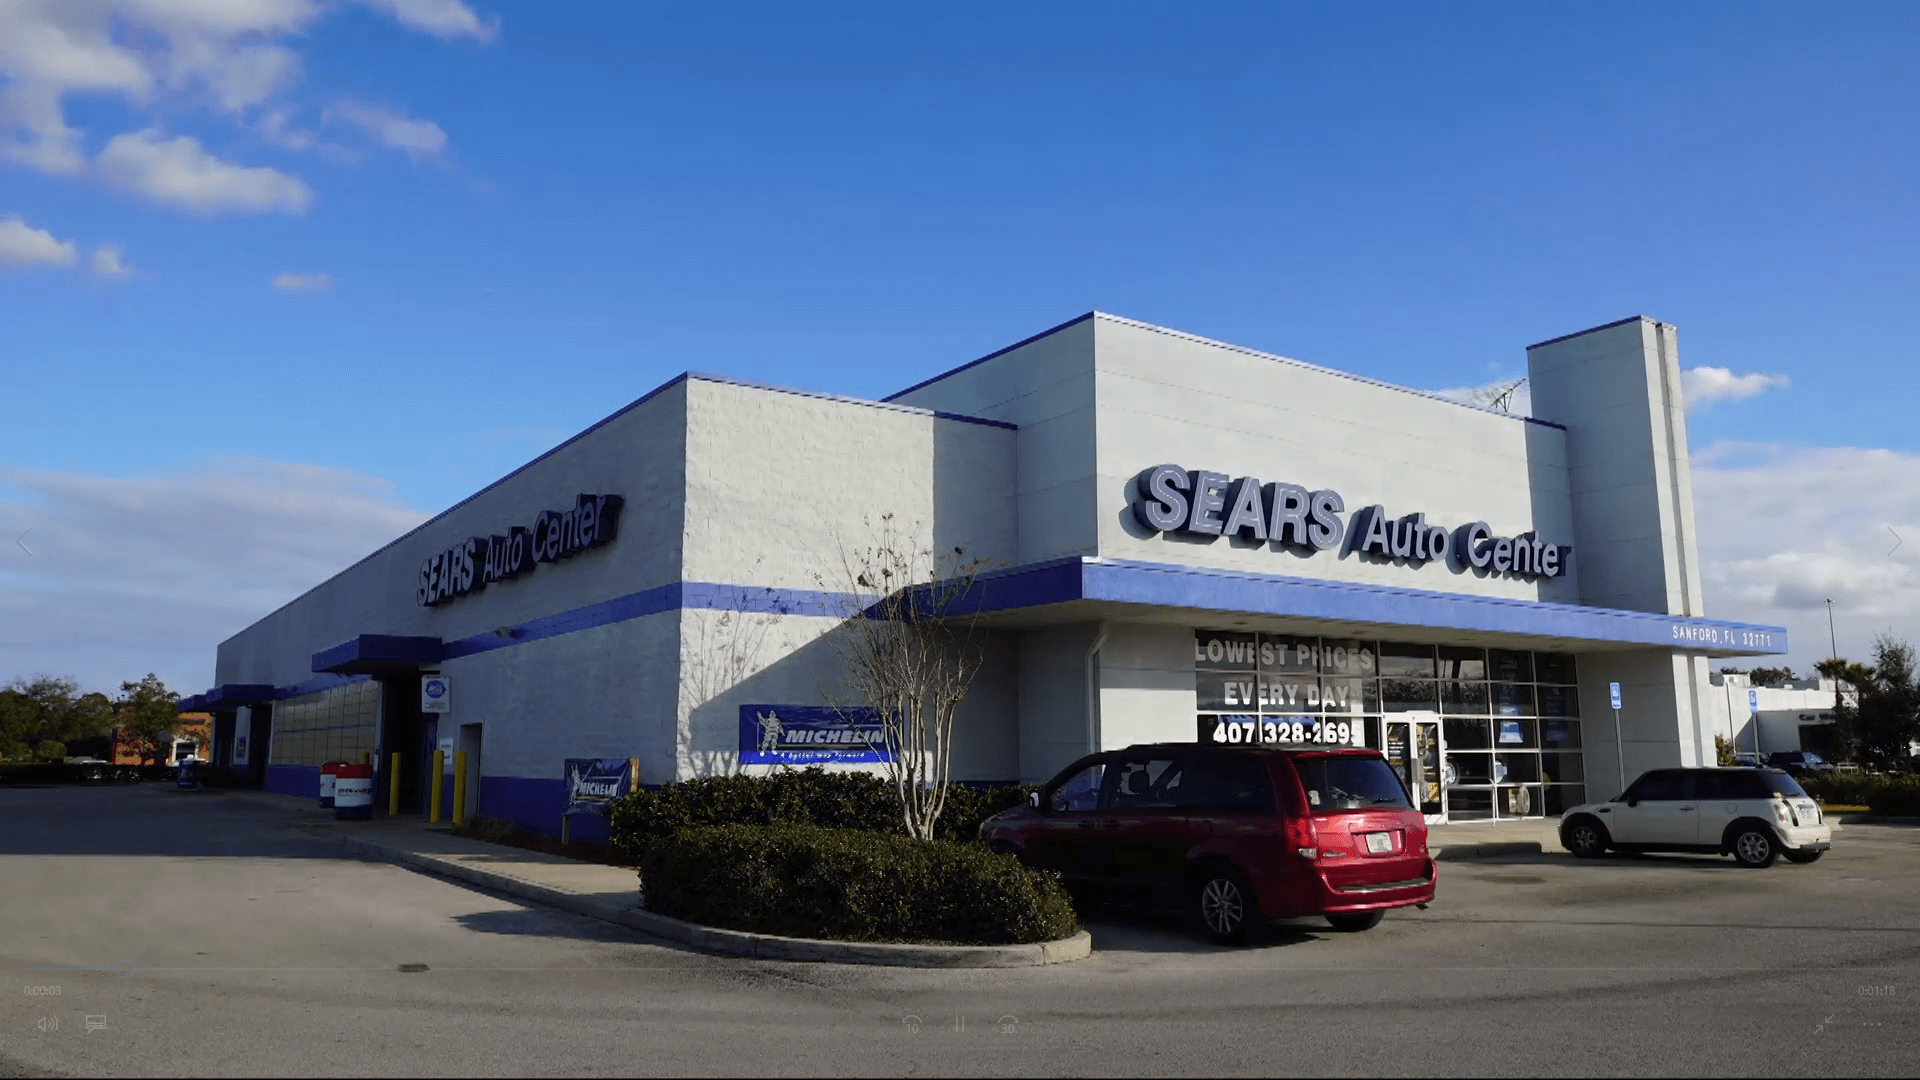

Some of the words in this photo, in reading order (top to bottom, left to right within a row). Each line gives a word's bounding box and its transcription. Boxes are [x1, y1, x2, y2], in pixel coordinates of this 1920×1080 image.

[1143, 464, 1345, 550] SEARS
[1363, 504, 1450, 562] Auto
[1466, 520, 1572, 578] Center
[416, 537, 476, 607] SEARS
[482, 525, 524, 583] Auto
[531, 493, 609, 564] Center
[1195, 638, 1288, 665] LOWEST
[1742, 632, 1771, 647] 32771
[1224, 682, 1299, 706] EVERY
[1307, 684, 1349, 707] DAY
[785, 729, 886, 744] MICHELIN
